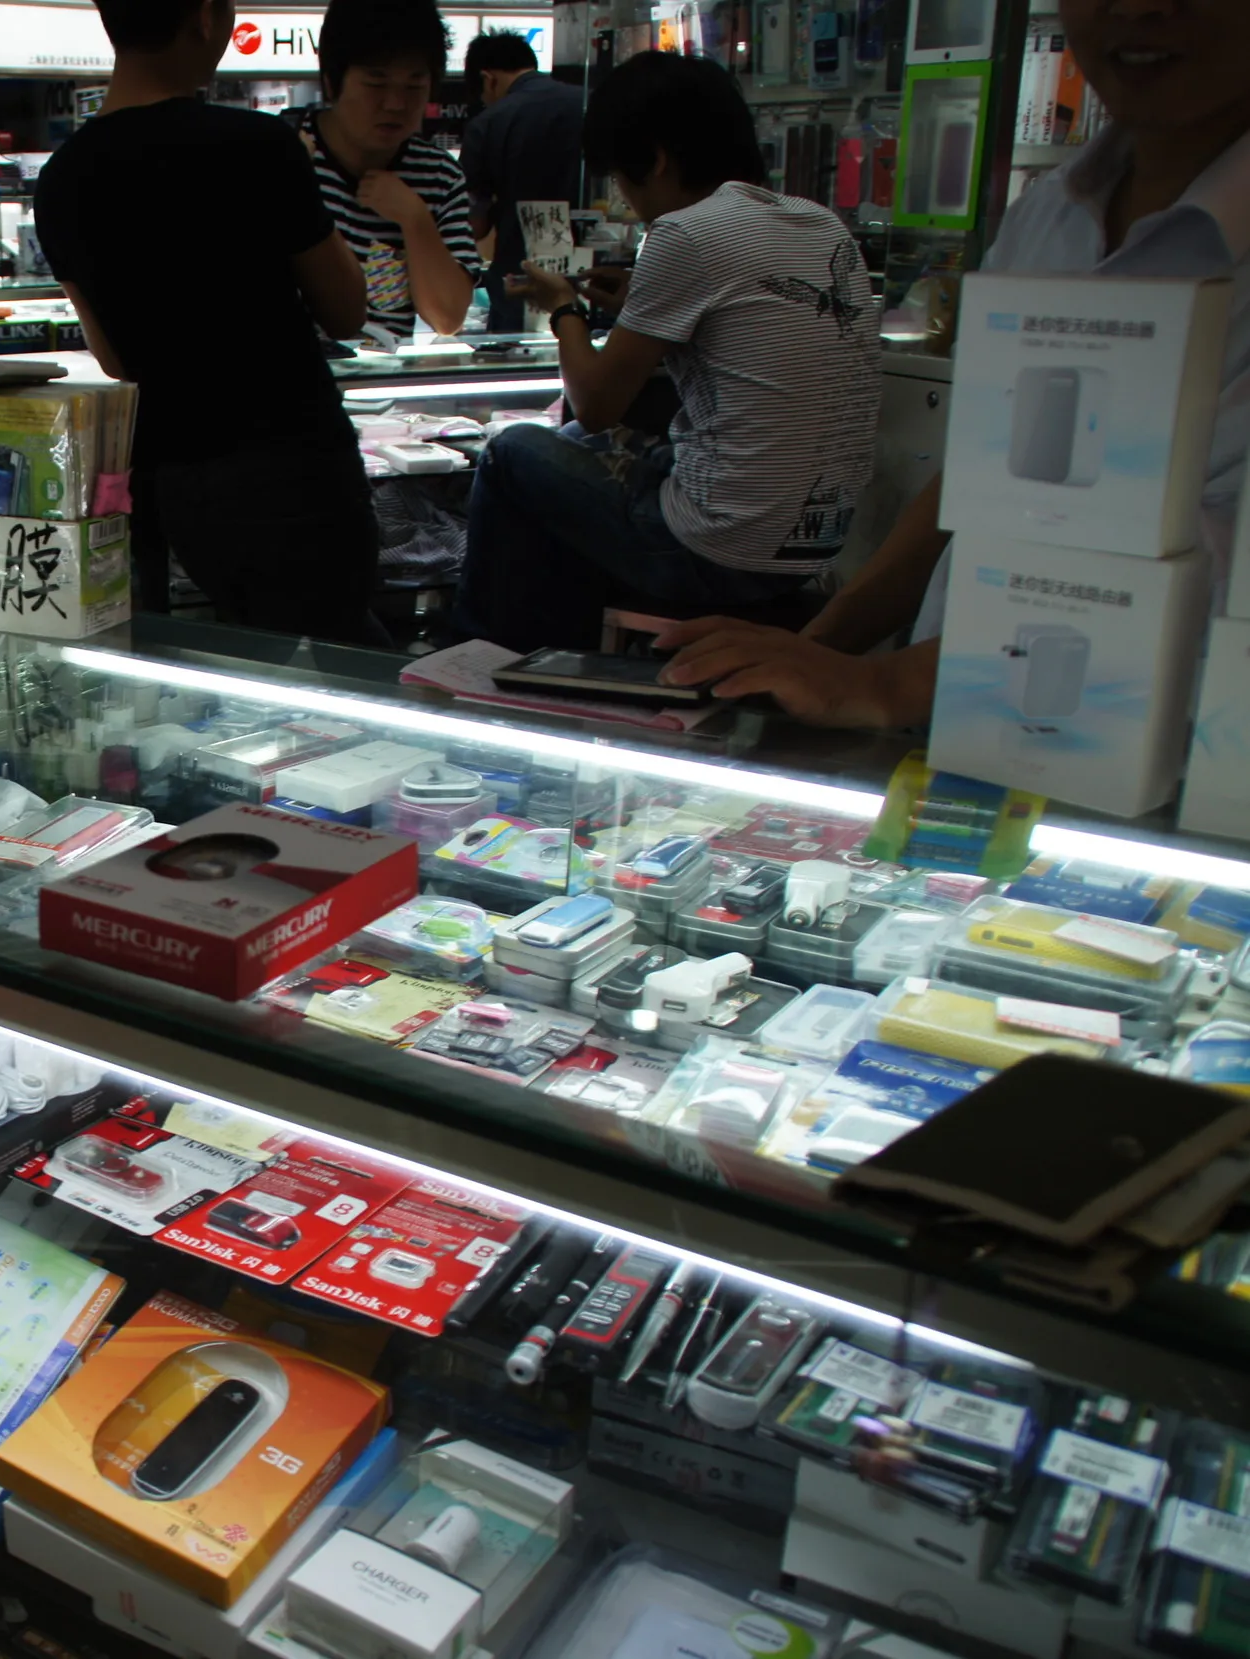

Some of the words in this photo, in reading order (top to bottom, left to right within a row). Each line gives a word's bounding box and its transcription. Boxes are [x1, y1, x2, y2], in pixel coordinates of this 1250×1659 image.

[273, 28, 320, 55] HiV
[1022, 315, 1156, 339] 迷你型无线路由器
[1009, 572, 1133, 608] 迷你型无线路由器
[72, 910, 202, 962] MERCURY
[244, 898, 334, 958] MERCURY
[334, 1199, 353, 1217] 8
[163, 1228, 241, 1263] SanDisk
[475, 1242, 494, 1260] 8
[302, 1275, 386, 1315] SanDisk
[204, 1308, 240, 1332] 3G
[259, 1445, 304, 1475] 3G
[351, 1560, 431, 1604] CHARGER
